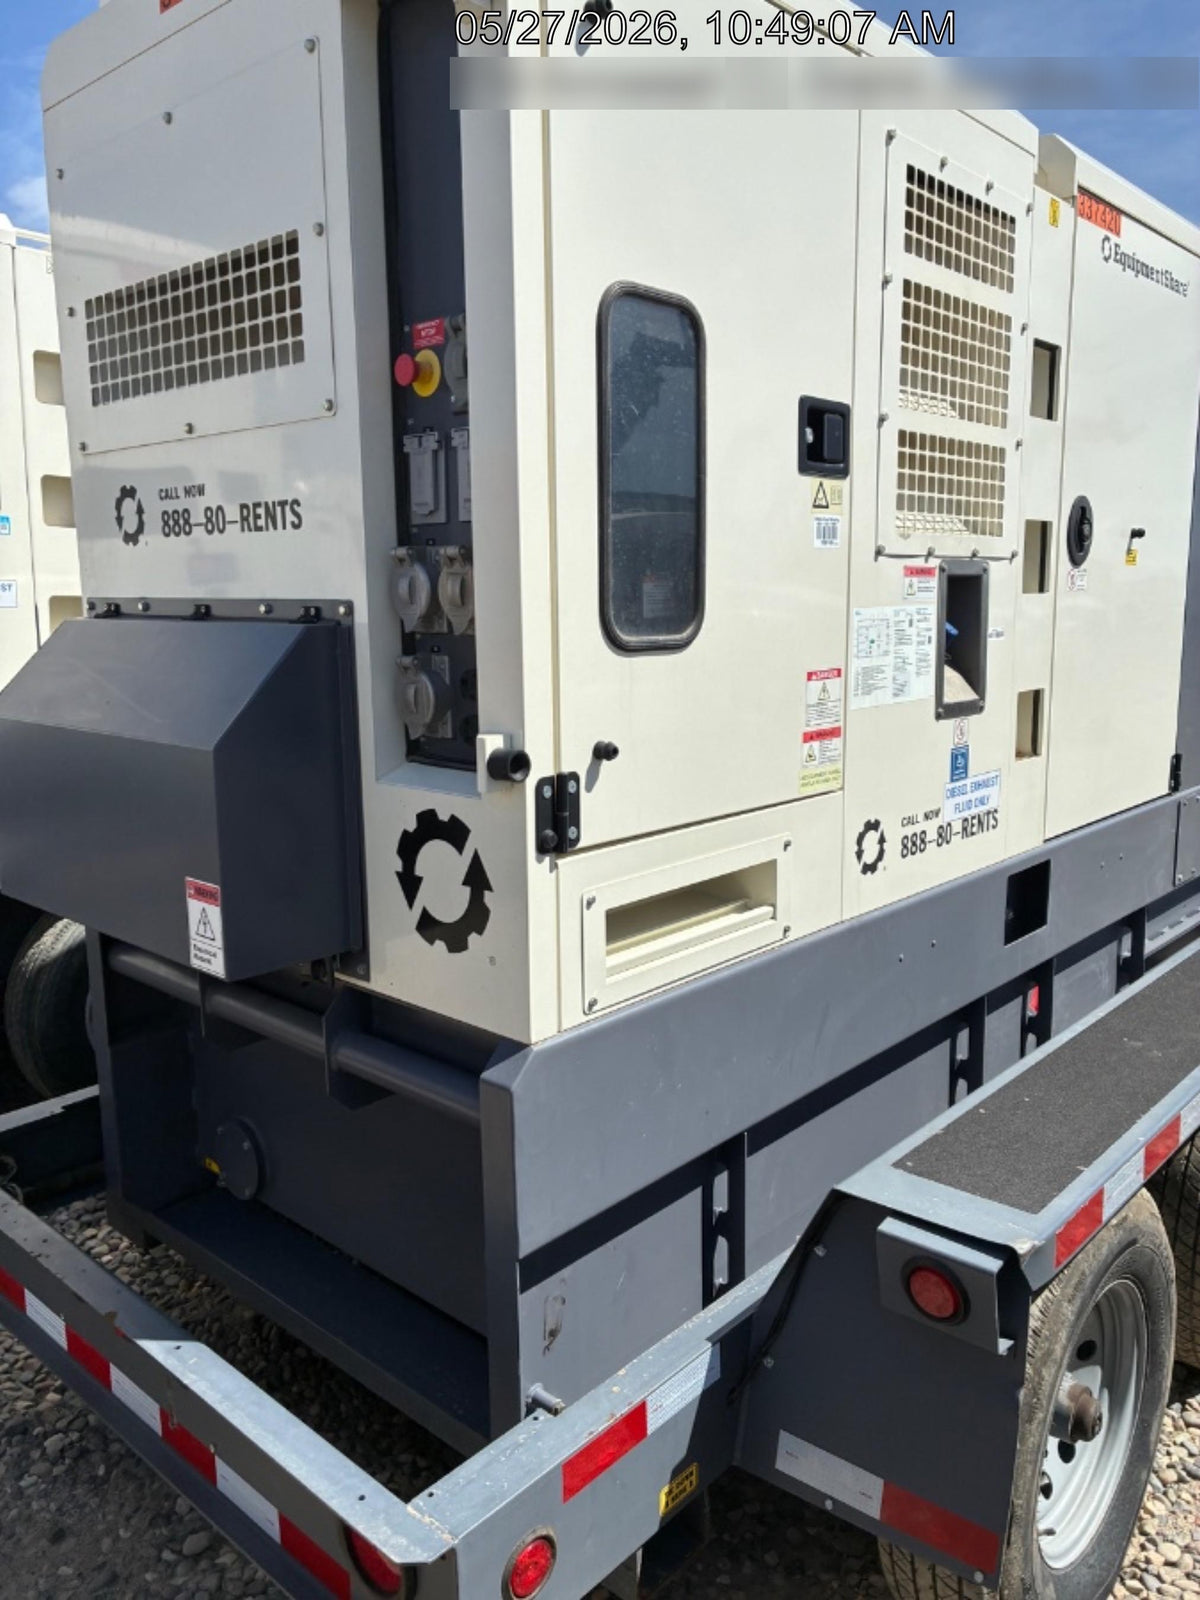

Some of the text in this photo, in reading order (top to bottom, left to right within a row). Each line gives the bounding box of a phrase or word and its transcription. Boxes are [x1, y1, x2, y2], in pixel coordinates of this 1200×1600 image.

[1113, 242, 1188, 298] EquipmentShare
[158, 483, 206, 501] CALL NOW
[161, 498, 303, 538] 888-80-RENTS
[900, 808, 999, 859] 888-80-RENTS
[901, 808, 941, 827] CALL NOW
